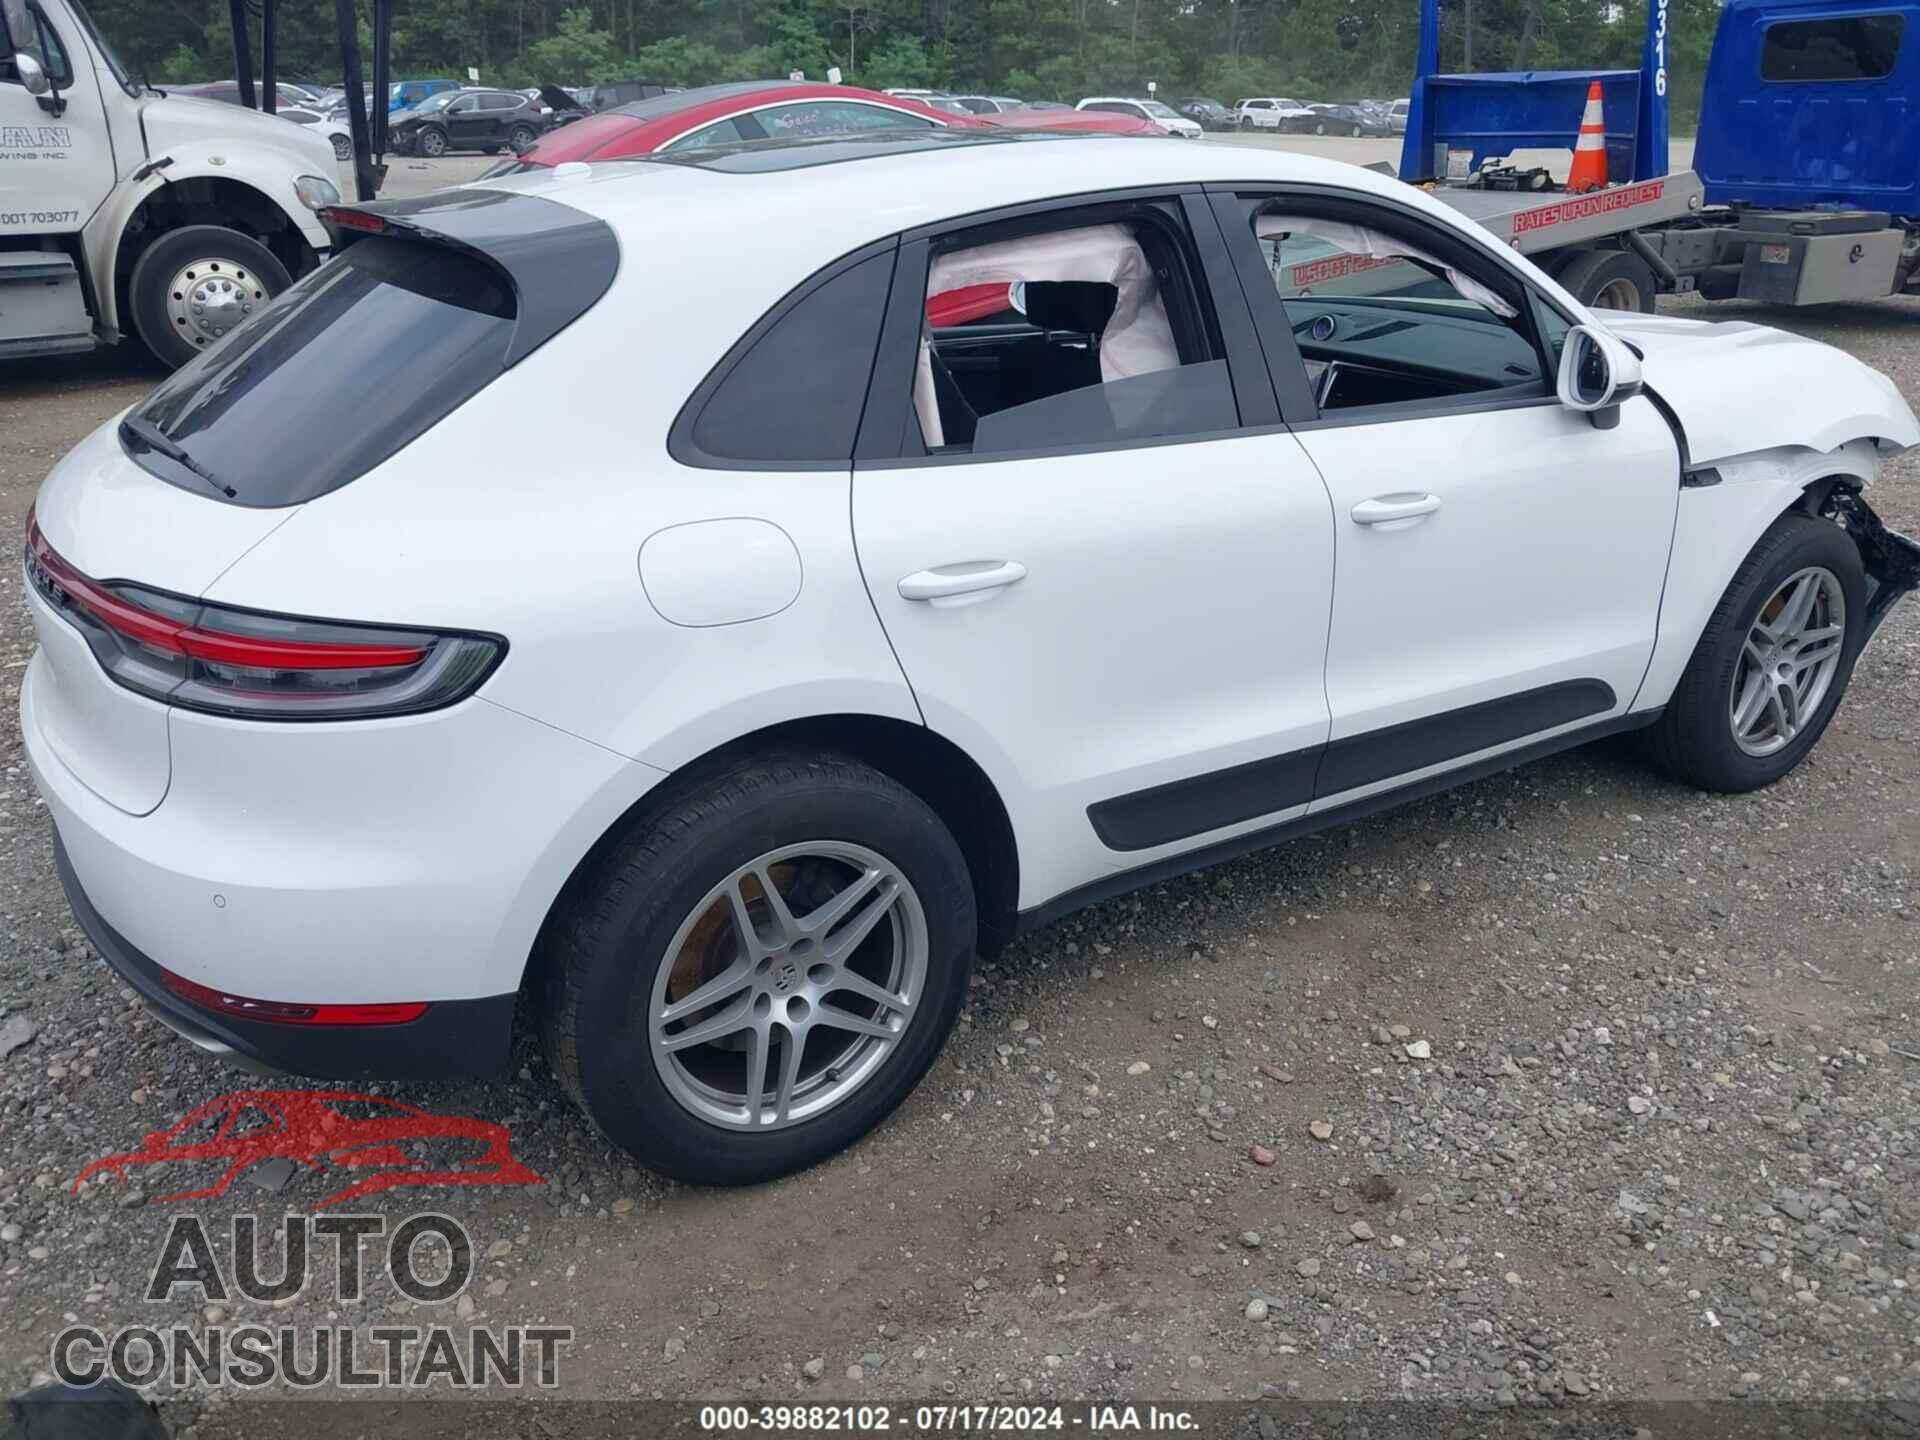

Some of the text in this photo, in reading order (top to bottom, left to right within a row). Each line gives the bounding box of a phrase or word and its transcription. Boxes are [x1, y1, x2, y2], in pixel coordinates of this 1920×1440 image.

[1655, 0, 1668, 96] 316
[29, 210, 79, 223] 703077
[1513, 181, 1665, 233] RATES UPON REQUEST
